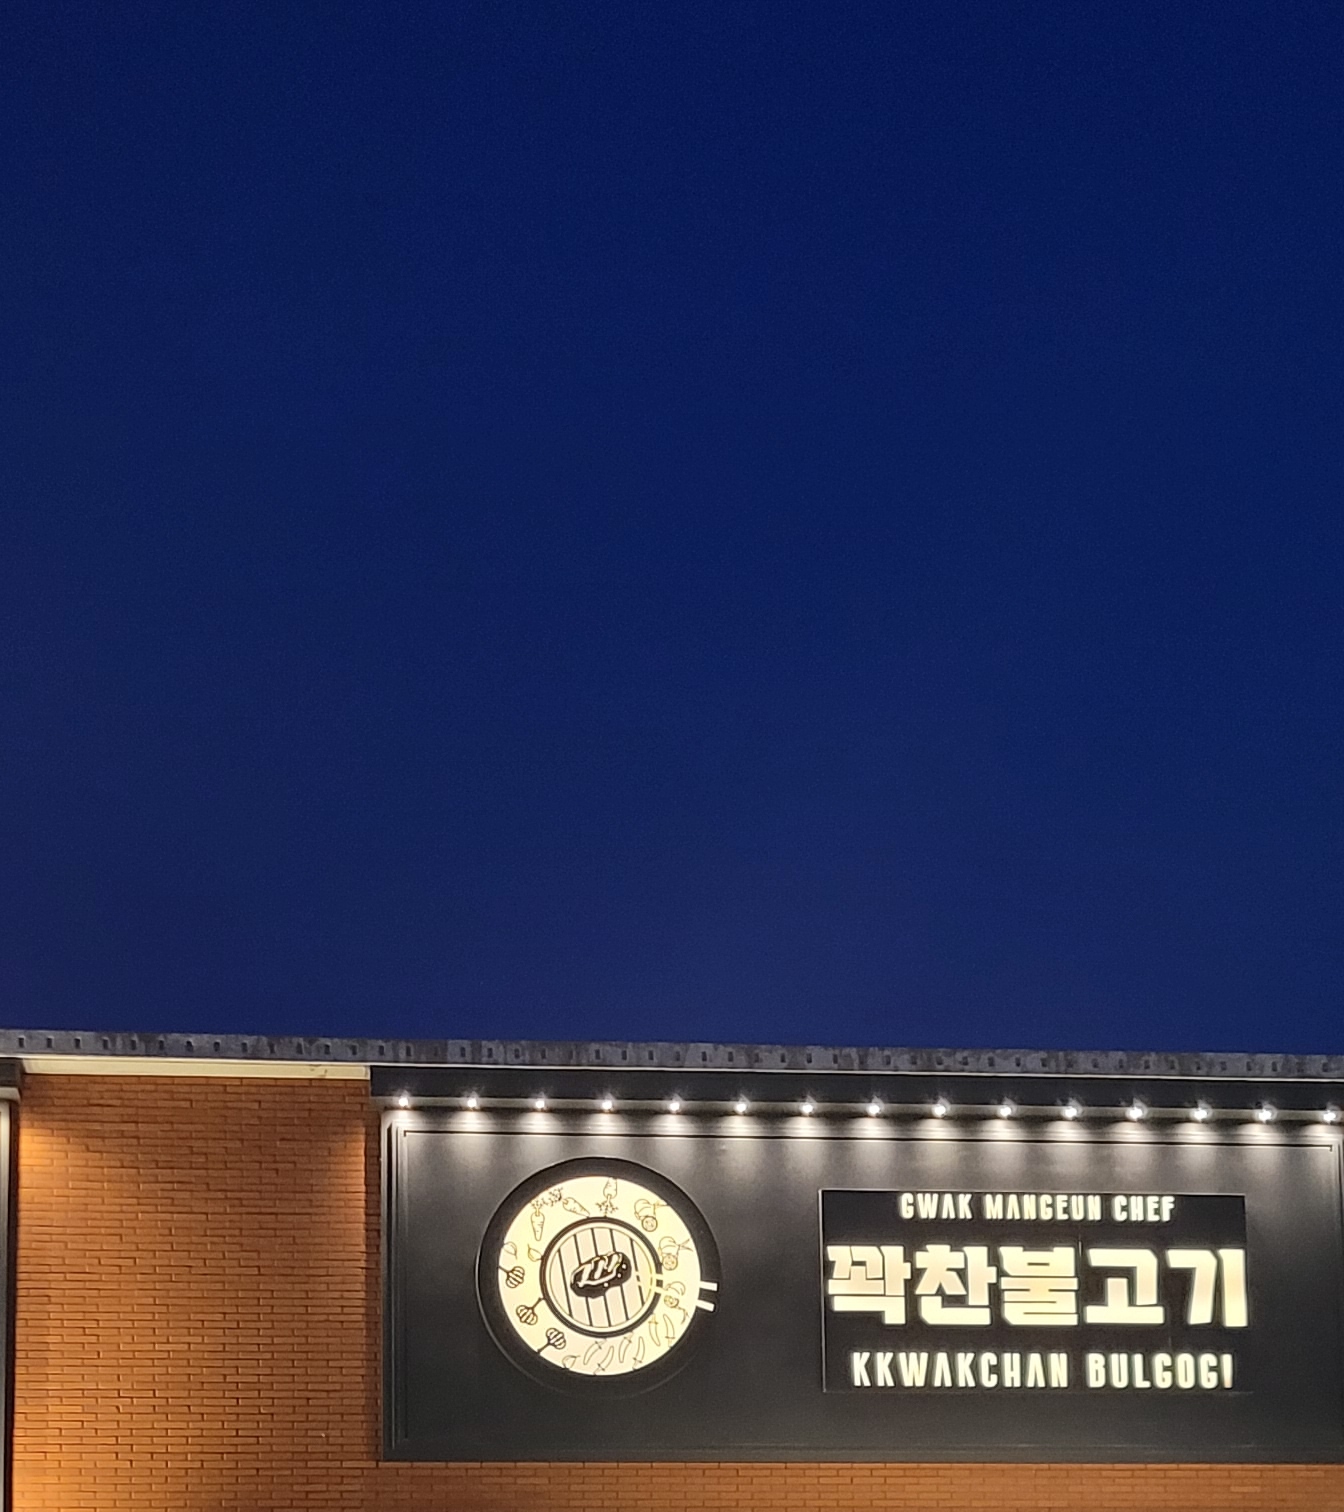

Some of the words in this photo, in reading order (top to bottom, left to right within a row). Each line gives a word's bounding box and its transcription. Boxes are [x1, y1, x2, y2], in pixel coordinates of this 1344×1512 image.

[899, 1192, 972, 1220] GWAK
[984, 1193, 1102, 1221] MANGEUN
[1113, 1195, 1176, 1223] CHEF
[826, 1244, 1249, 1328] 꽉찬불고기
[851, 1351, 1069, 1388] KKWAKCHAN
[1086, 1352, 1234, 1389] BULGOGI
